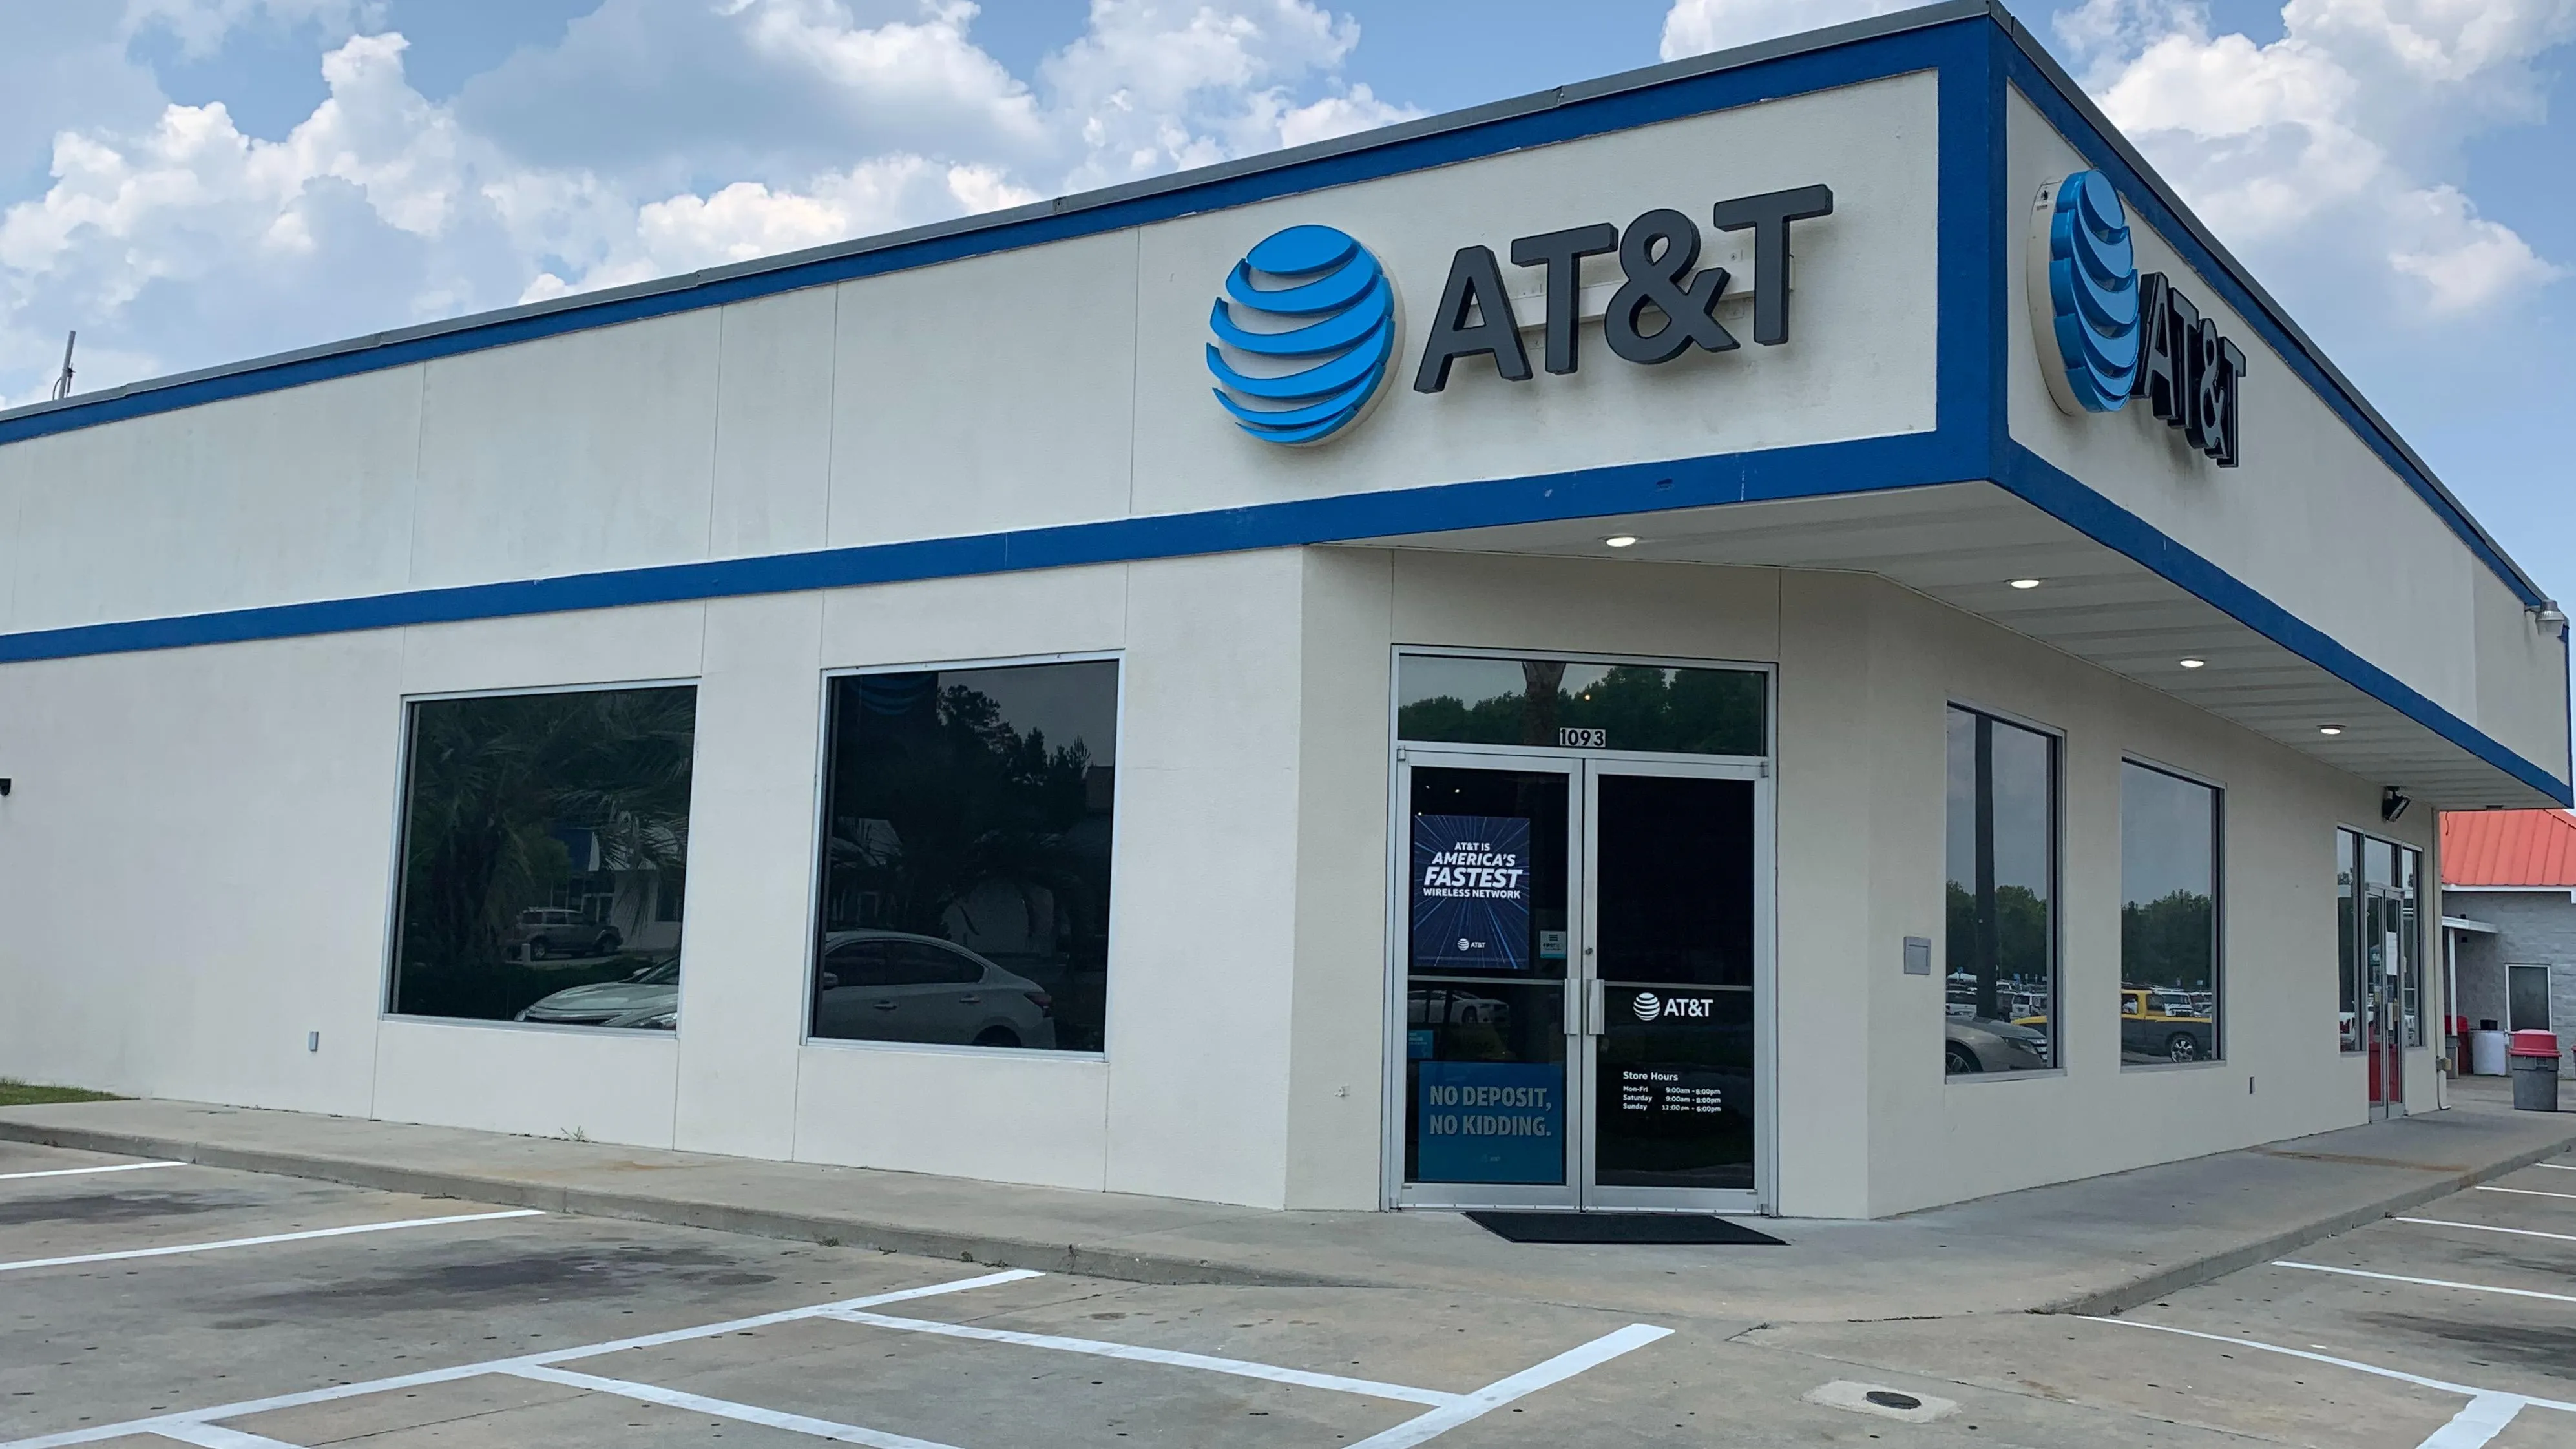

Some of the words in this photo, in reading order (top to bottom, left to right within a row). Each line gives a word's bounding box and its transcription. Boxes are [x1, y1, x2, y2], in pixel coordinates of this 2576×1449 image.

[1414, 185, 1833, 393] AT&T
[2130, 271, 2246, 468] AT&T
[1560, 729, 1604, 746] 1093
[1454, 842, 1479, 851] AT&T
[1481, 843, 1491, 851] IS
[1431, 851, 1516, 867] AMERICA'S
[1423, 866, 1524, 888] FASTEST
[1423, 888, 1471, 897] WIRELESS
[1472, 889, 1521, 899] NETWORK
[1664, 998, 1713, 1017] AT&T
[1623, 1071, 1648, 1080] Store
[1651, 1072, 1679, 1081] Hours
[1430, 1085, 1458, 1105] NO
[1463, 1086, 1551, 1112] DEPOSIT,
[1623, 1094, 1653, 1103] Saturday
[1623, 1103, 1648, 1111] Sunday
[1429, 1114, 1458, 1135] NO
[1463, 1115, 1551, 1136] KIDDING.
